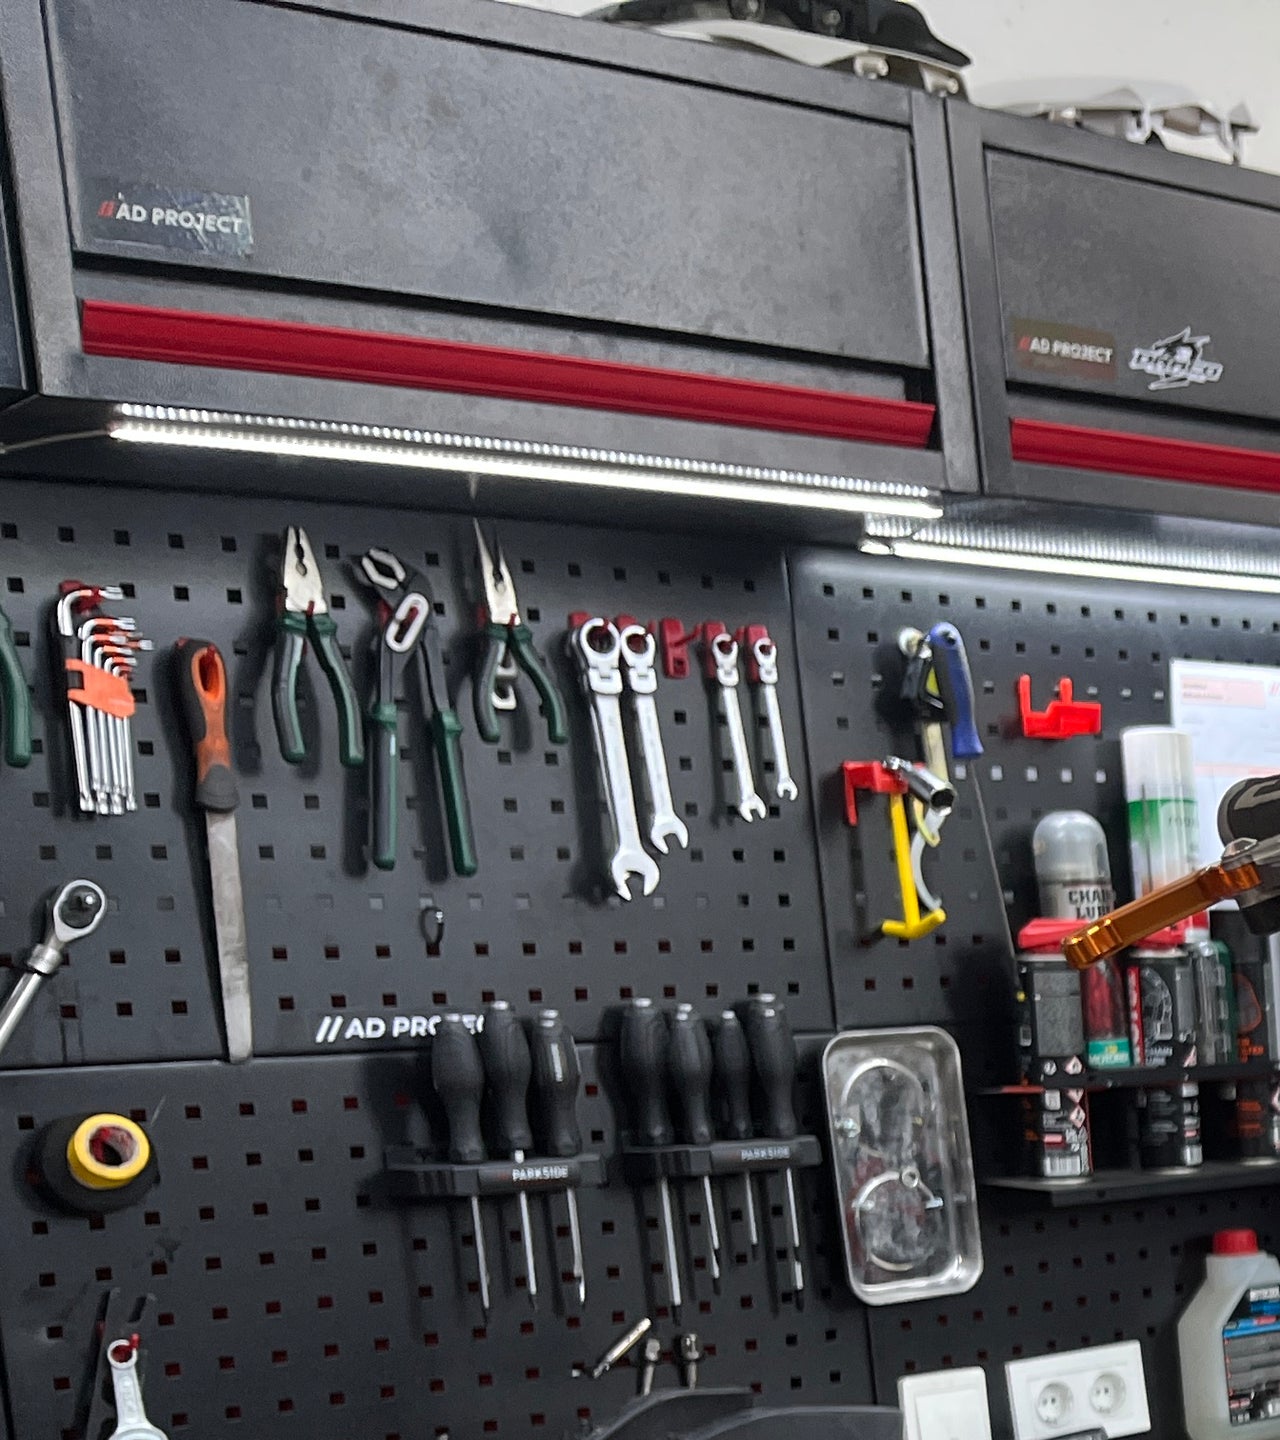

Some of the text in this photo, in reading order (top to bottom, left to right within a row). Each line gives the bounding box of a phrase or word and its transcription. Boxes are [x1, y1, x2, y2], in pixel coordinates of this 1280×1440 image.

[152, 208, 243, 234] PROJECT
[1053, 340, 1113, 364] PROJECT
[512, 1165, 568, 1182] PARKSIDE
